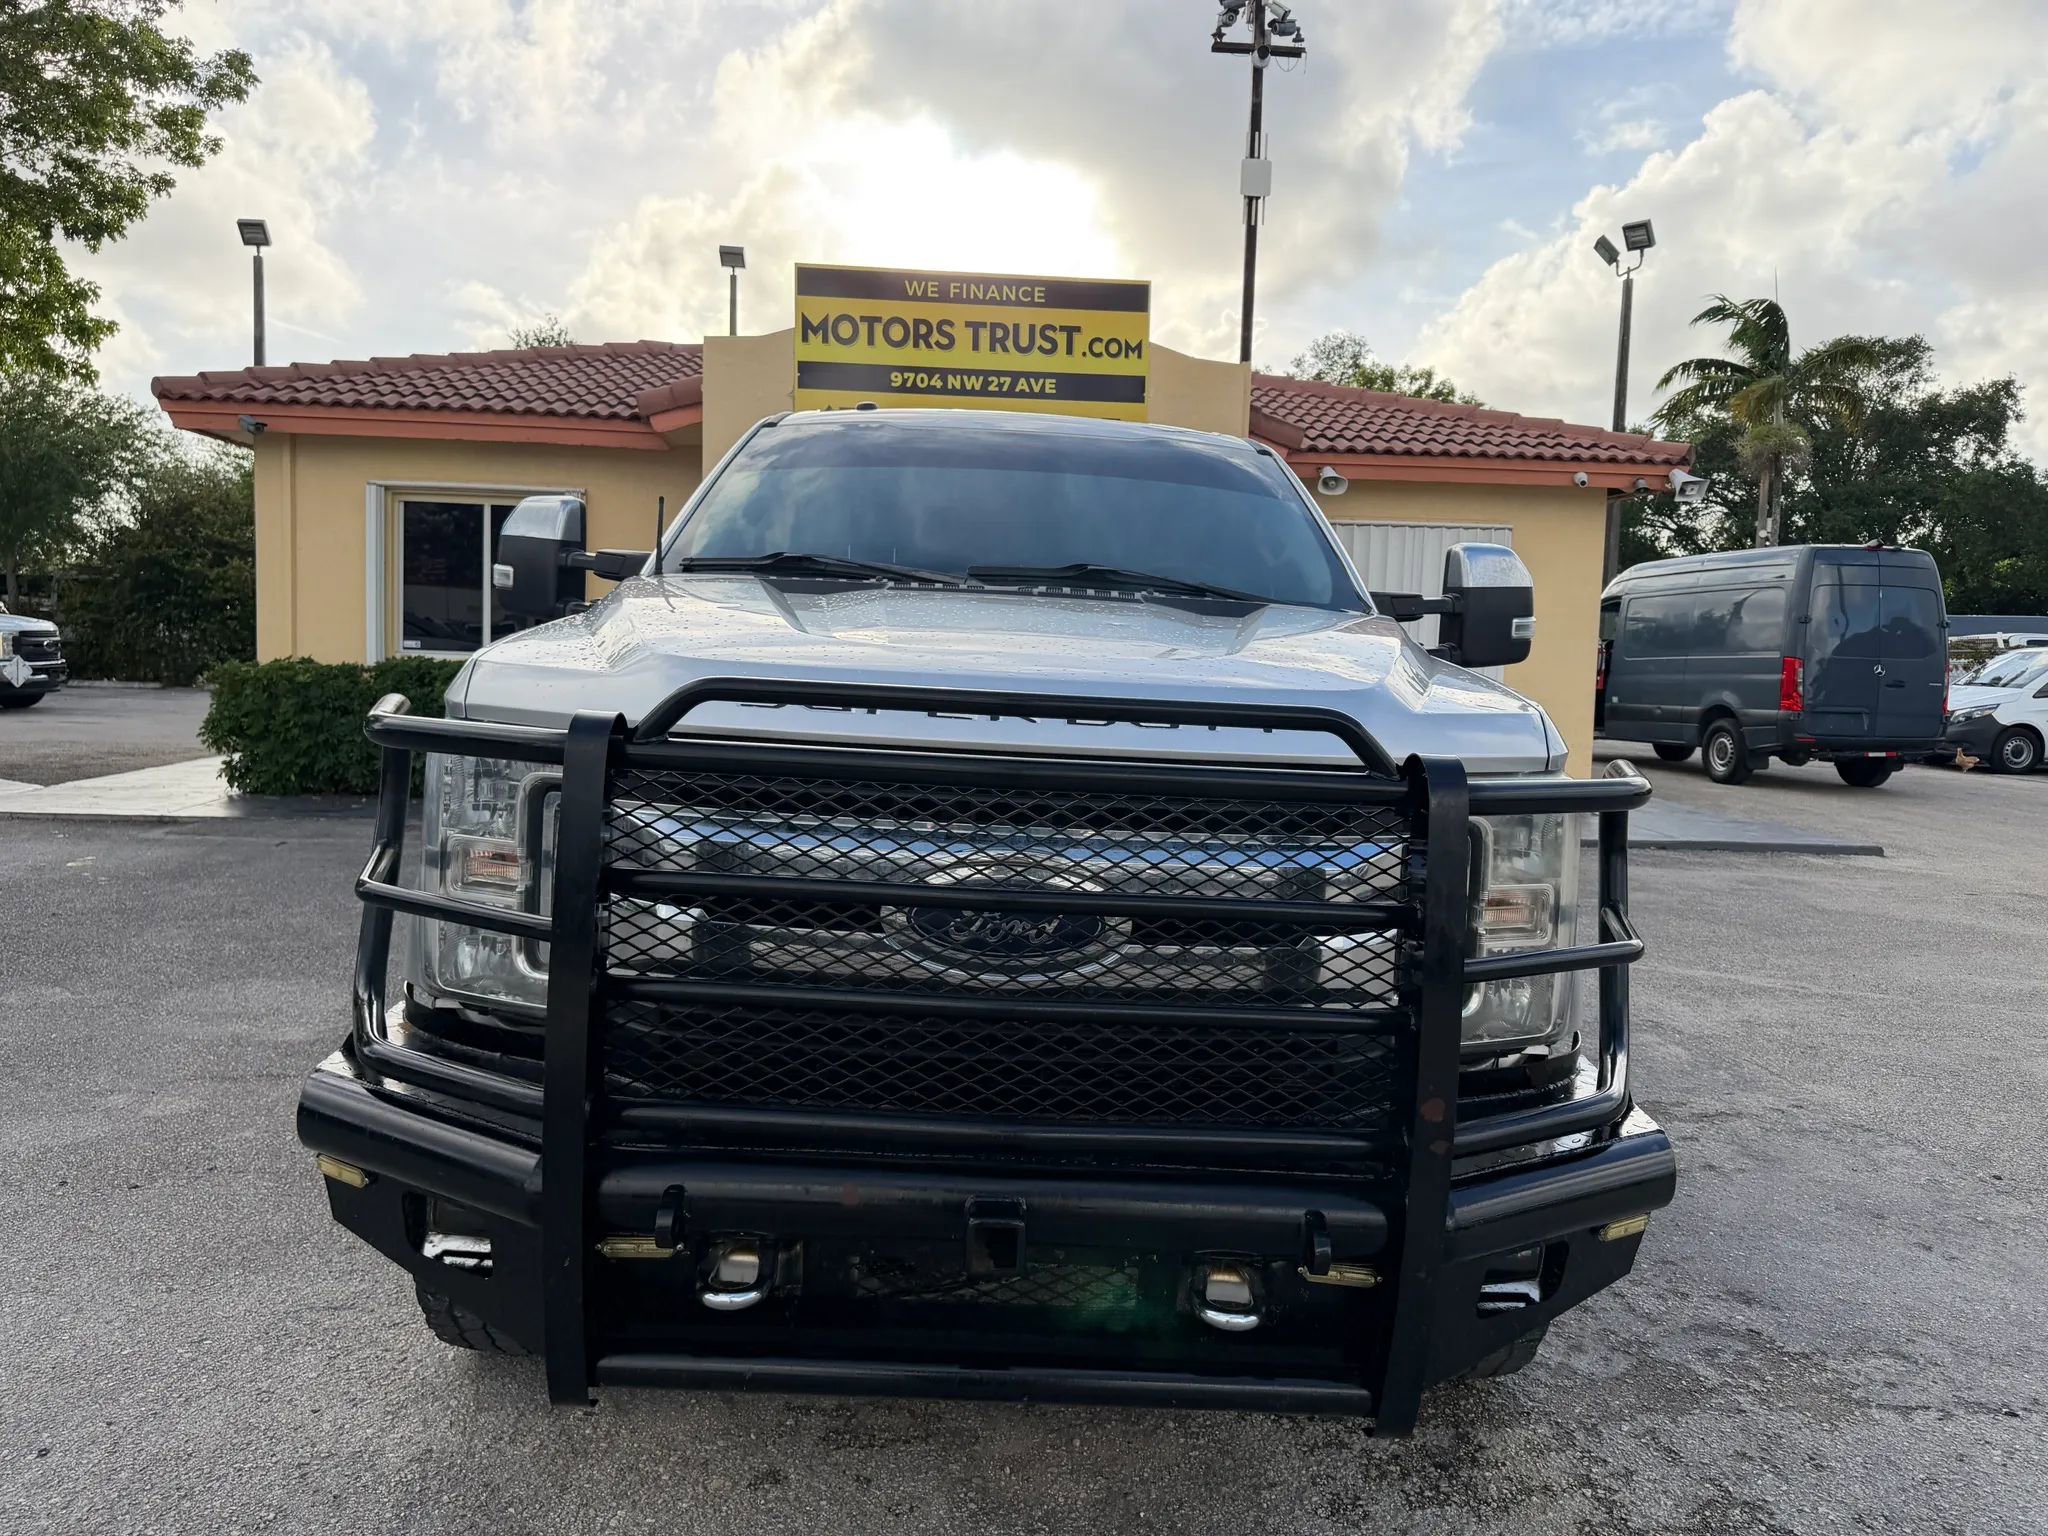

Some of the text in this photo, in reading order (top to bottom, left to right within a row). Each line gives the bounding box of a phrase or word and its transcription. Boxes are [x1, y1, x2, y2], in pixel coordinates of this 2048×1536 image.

[905, 280, 1046, 302] WE FINANCE
[801, 312, 956, 351] MOTORS
[890, 372, 1057, 394] 9704 NW 27 AVE
